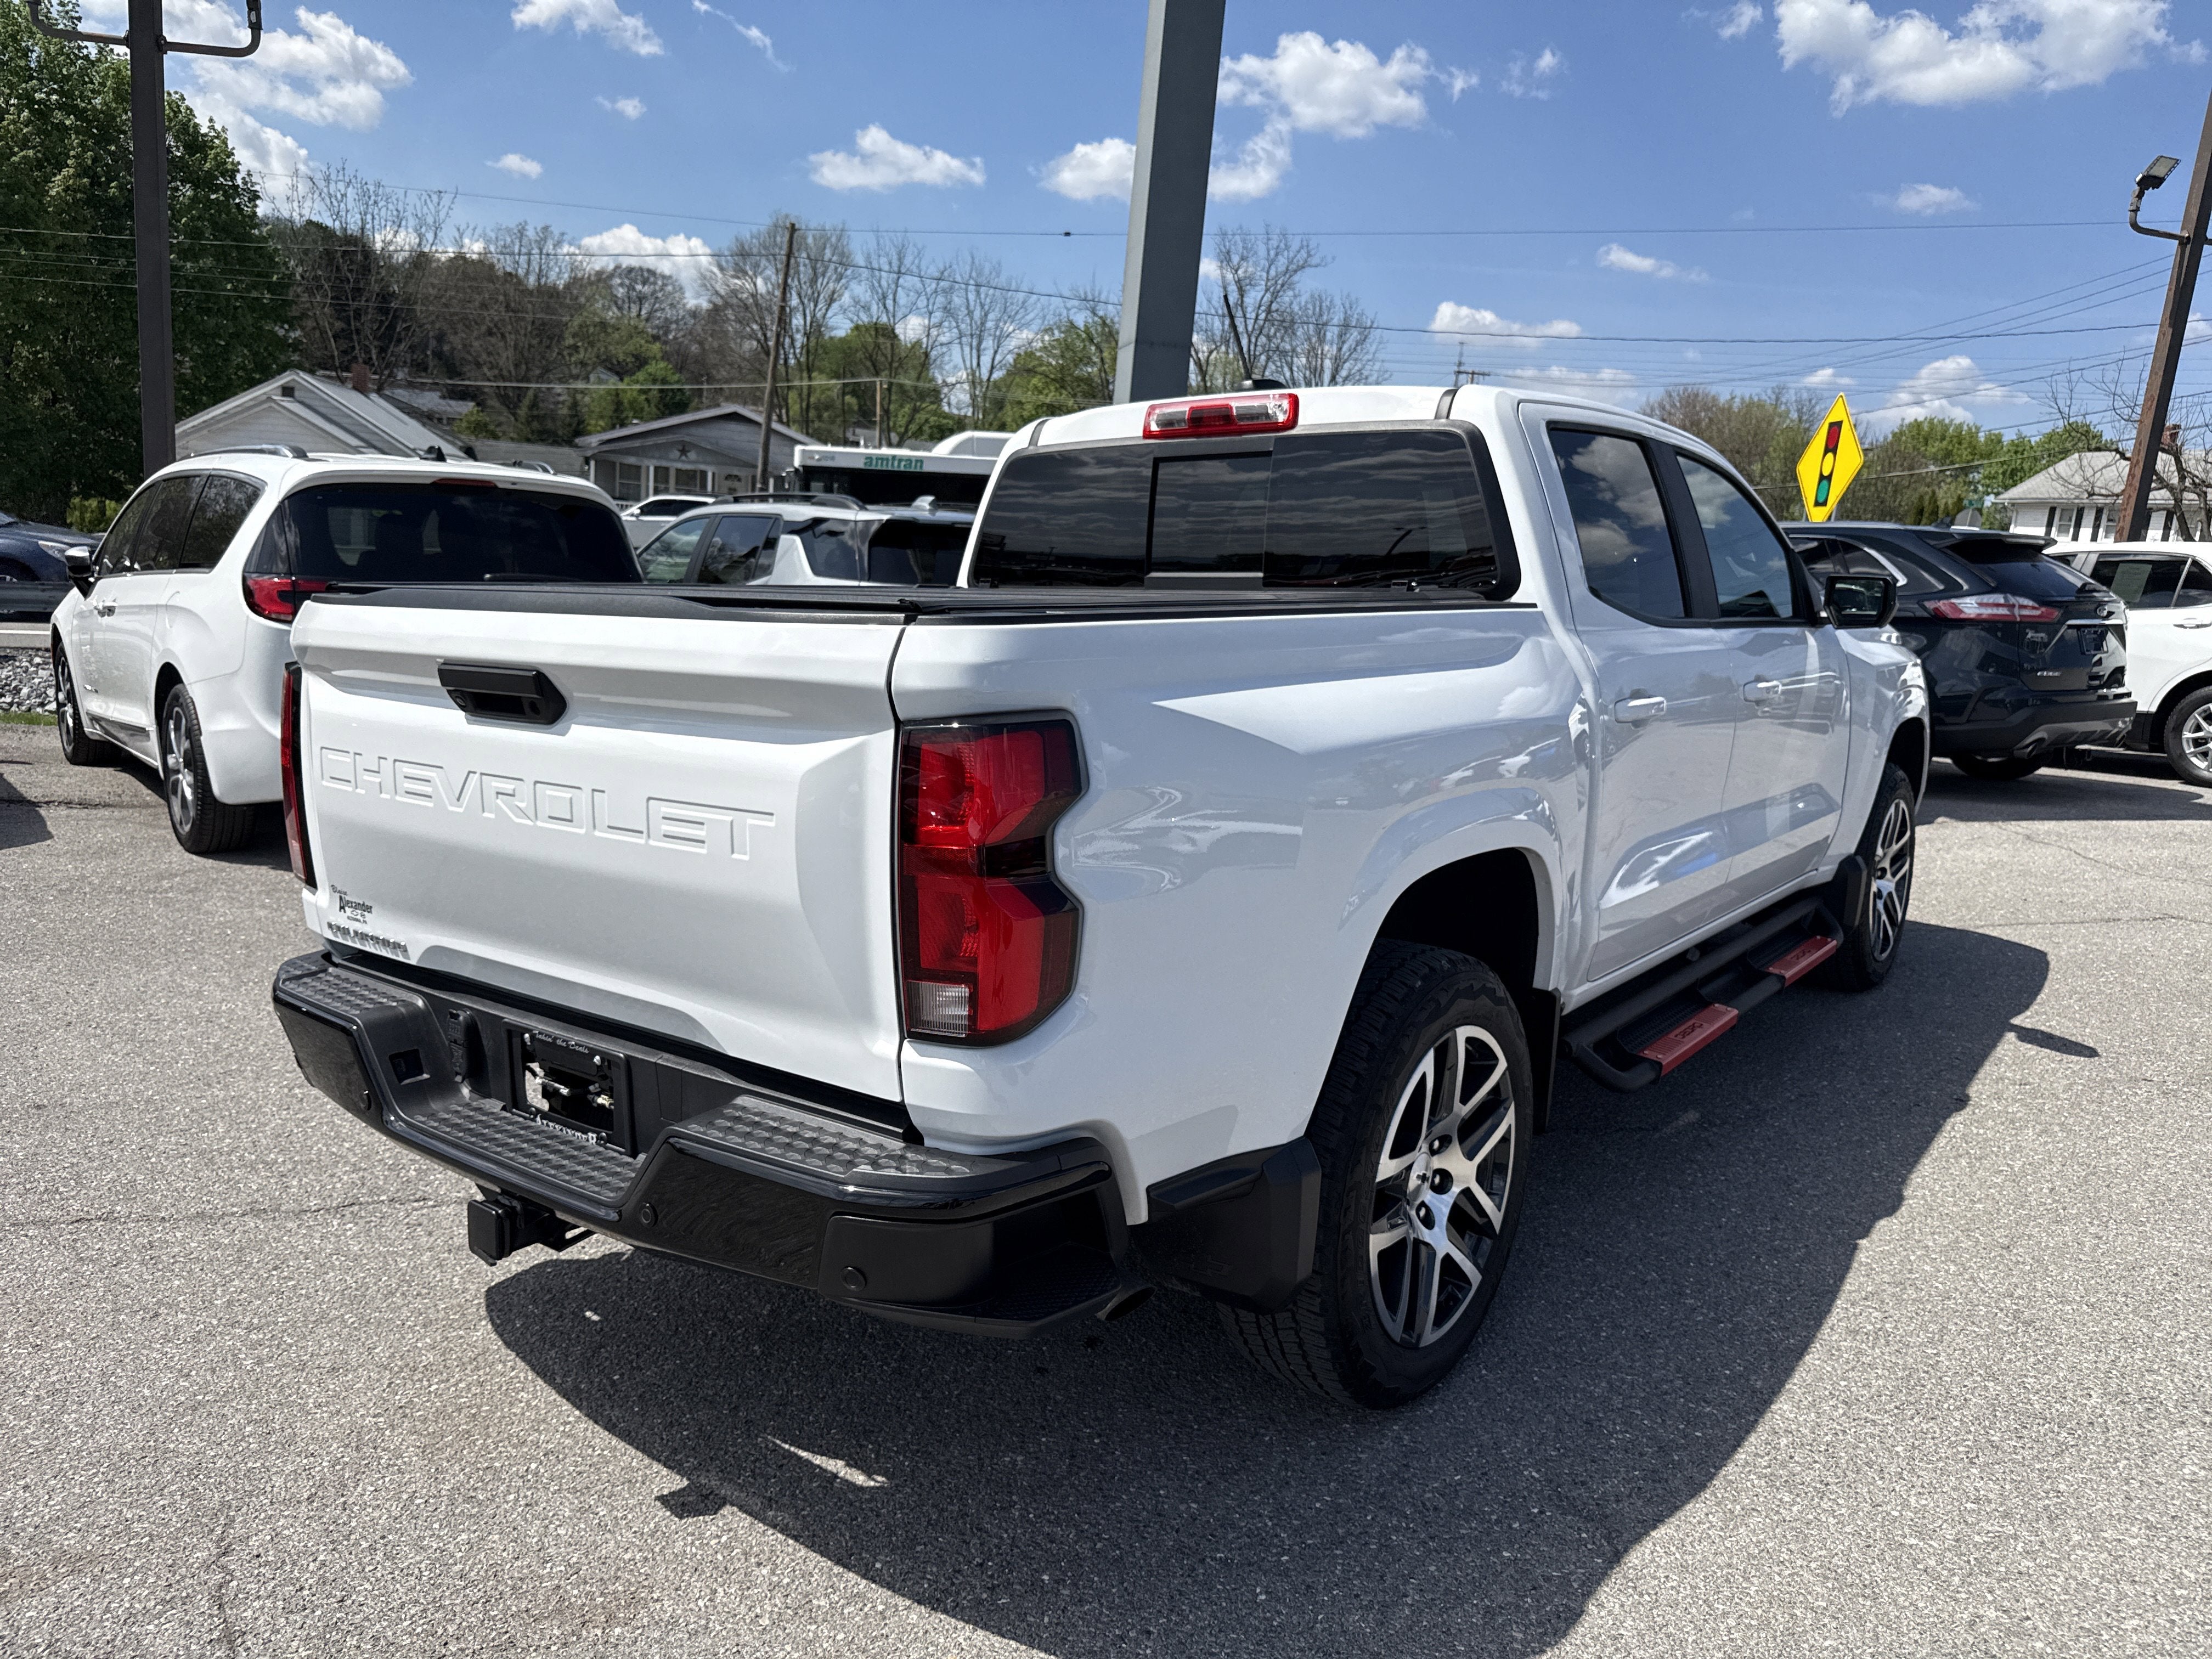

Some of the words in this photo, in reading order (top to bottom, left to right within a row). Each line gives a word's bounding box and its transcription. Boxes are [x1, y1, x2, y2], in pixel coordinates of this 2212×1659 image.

[864, 455, 924, 471] amtran
[319, 746, 776, 860] CHEVROLET
[338, 895, 373, 915] Alexander
